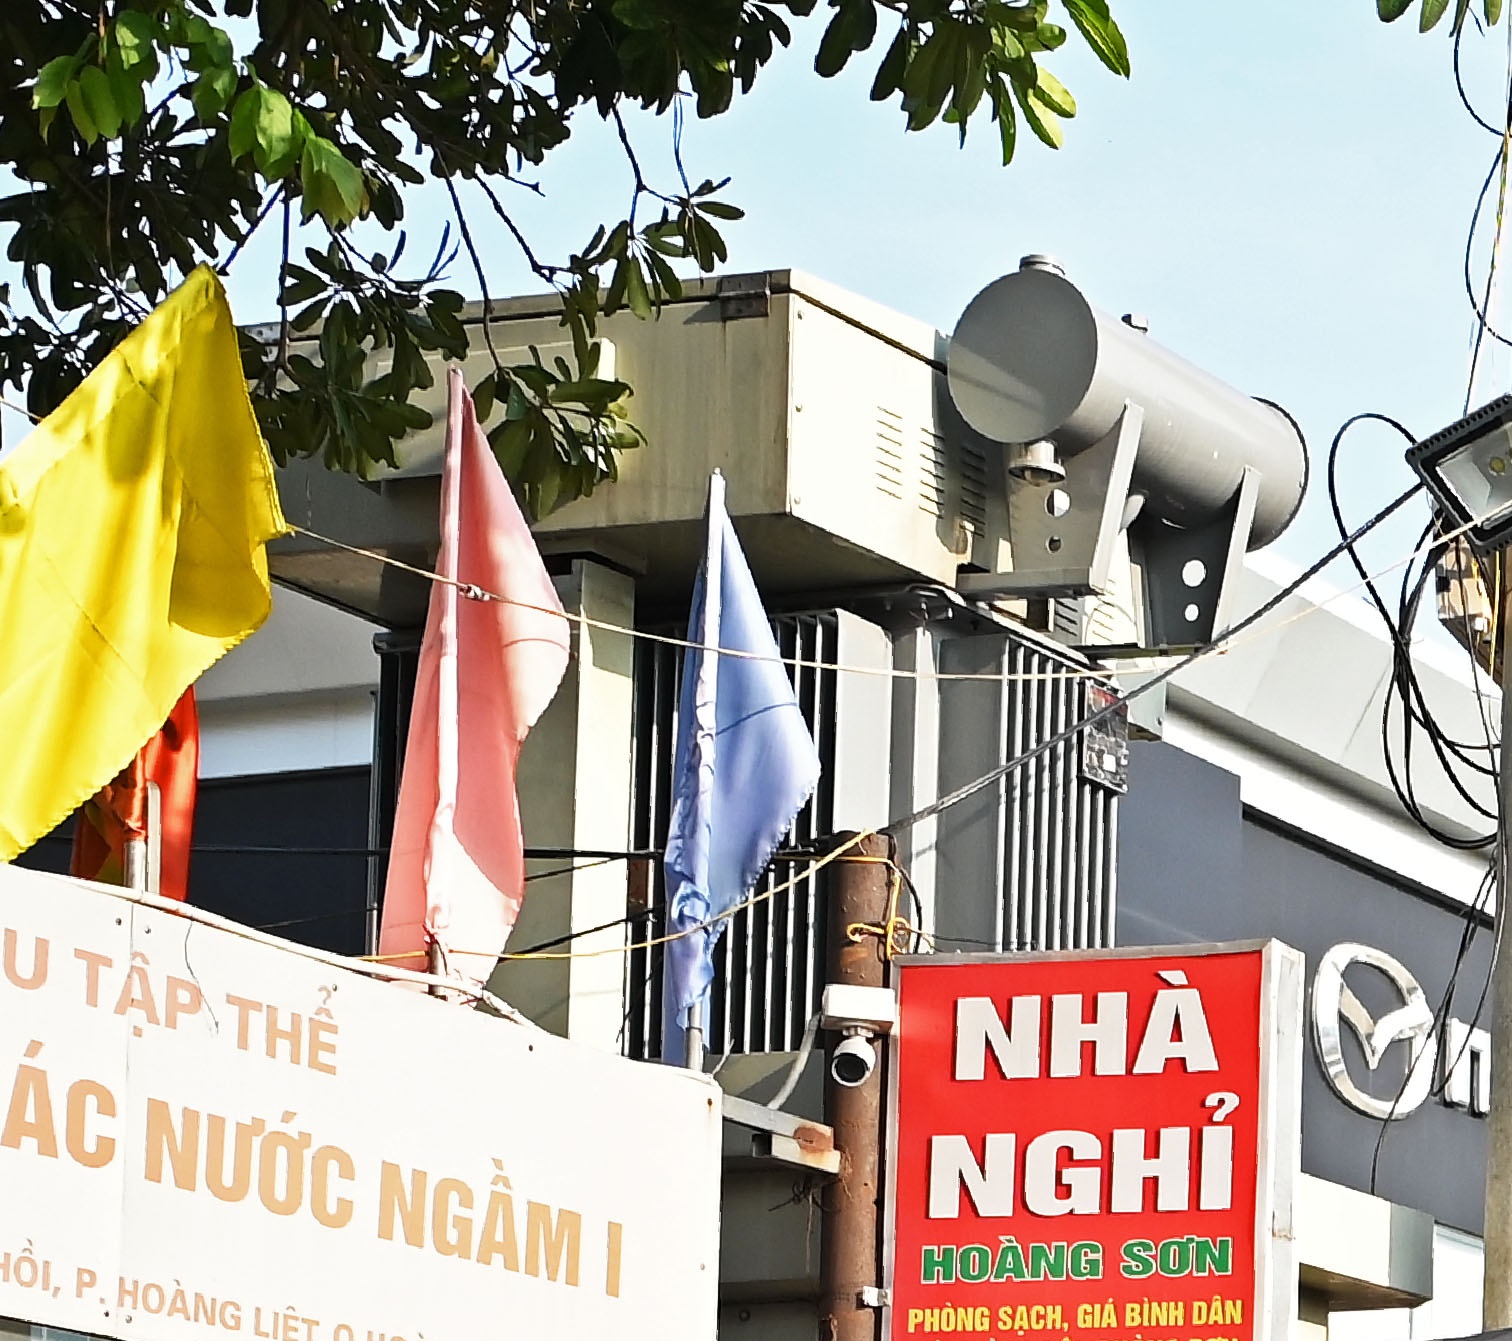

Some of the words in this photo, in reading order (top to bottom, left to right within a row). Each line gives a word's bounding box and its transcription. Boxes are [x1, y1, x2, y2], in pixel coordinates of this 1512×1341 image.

[74, 947, 203, 1038] TẬP
[226, 984, 340, 1076] THỂ
[955, 970, 1220, 1081] NHÀ
[143, 1097, 355, 1231] NƯỚC
[378, 1157, 583, 1288] NGẦM
[928, 1091, 1240, 1218] NGHỈ
[75, 1270, 106, 1301] P.
[117, 1273, 242, 1332] HOÀNG
[920, 1235, 1103, 1284] HOÀNG
[1121, 1235, 1233, 1279] SƠN
[908, 1302, 990, 1333] PHÒNG
[997, 1304, 1069, 1336] SẠCH,
[1077, 1298, 1117, 1329] GIÁ
[1125, 1297, 1185, 1327] BÌNH
[1192, 1295, 1243, 1326] DÂN
